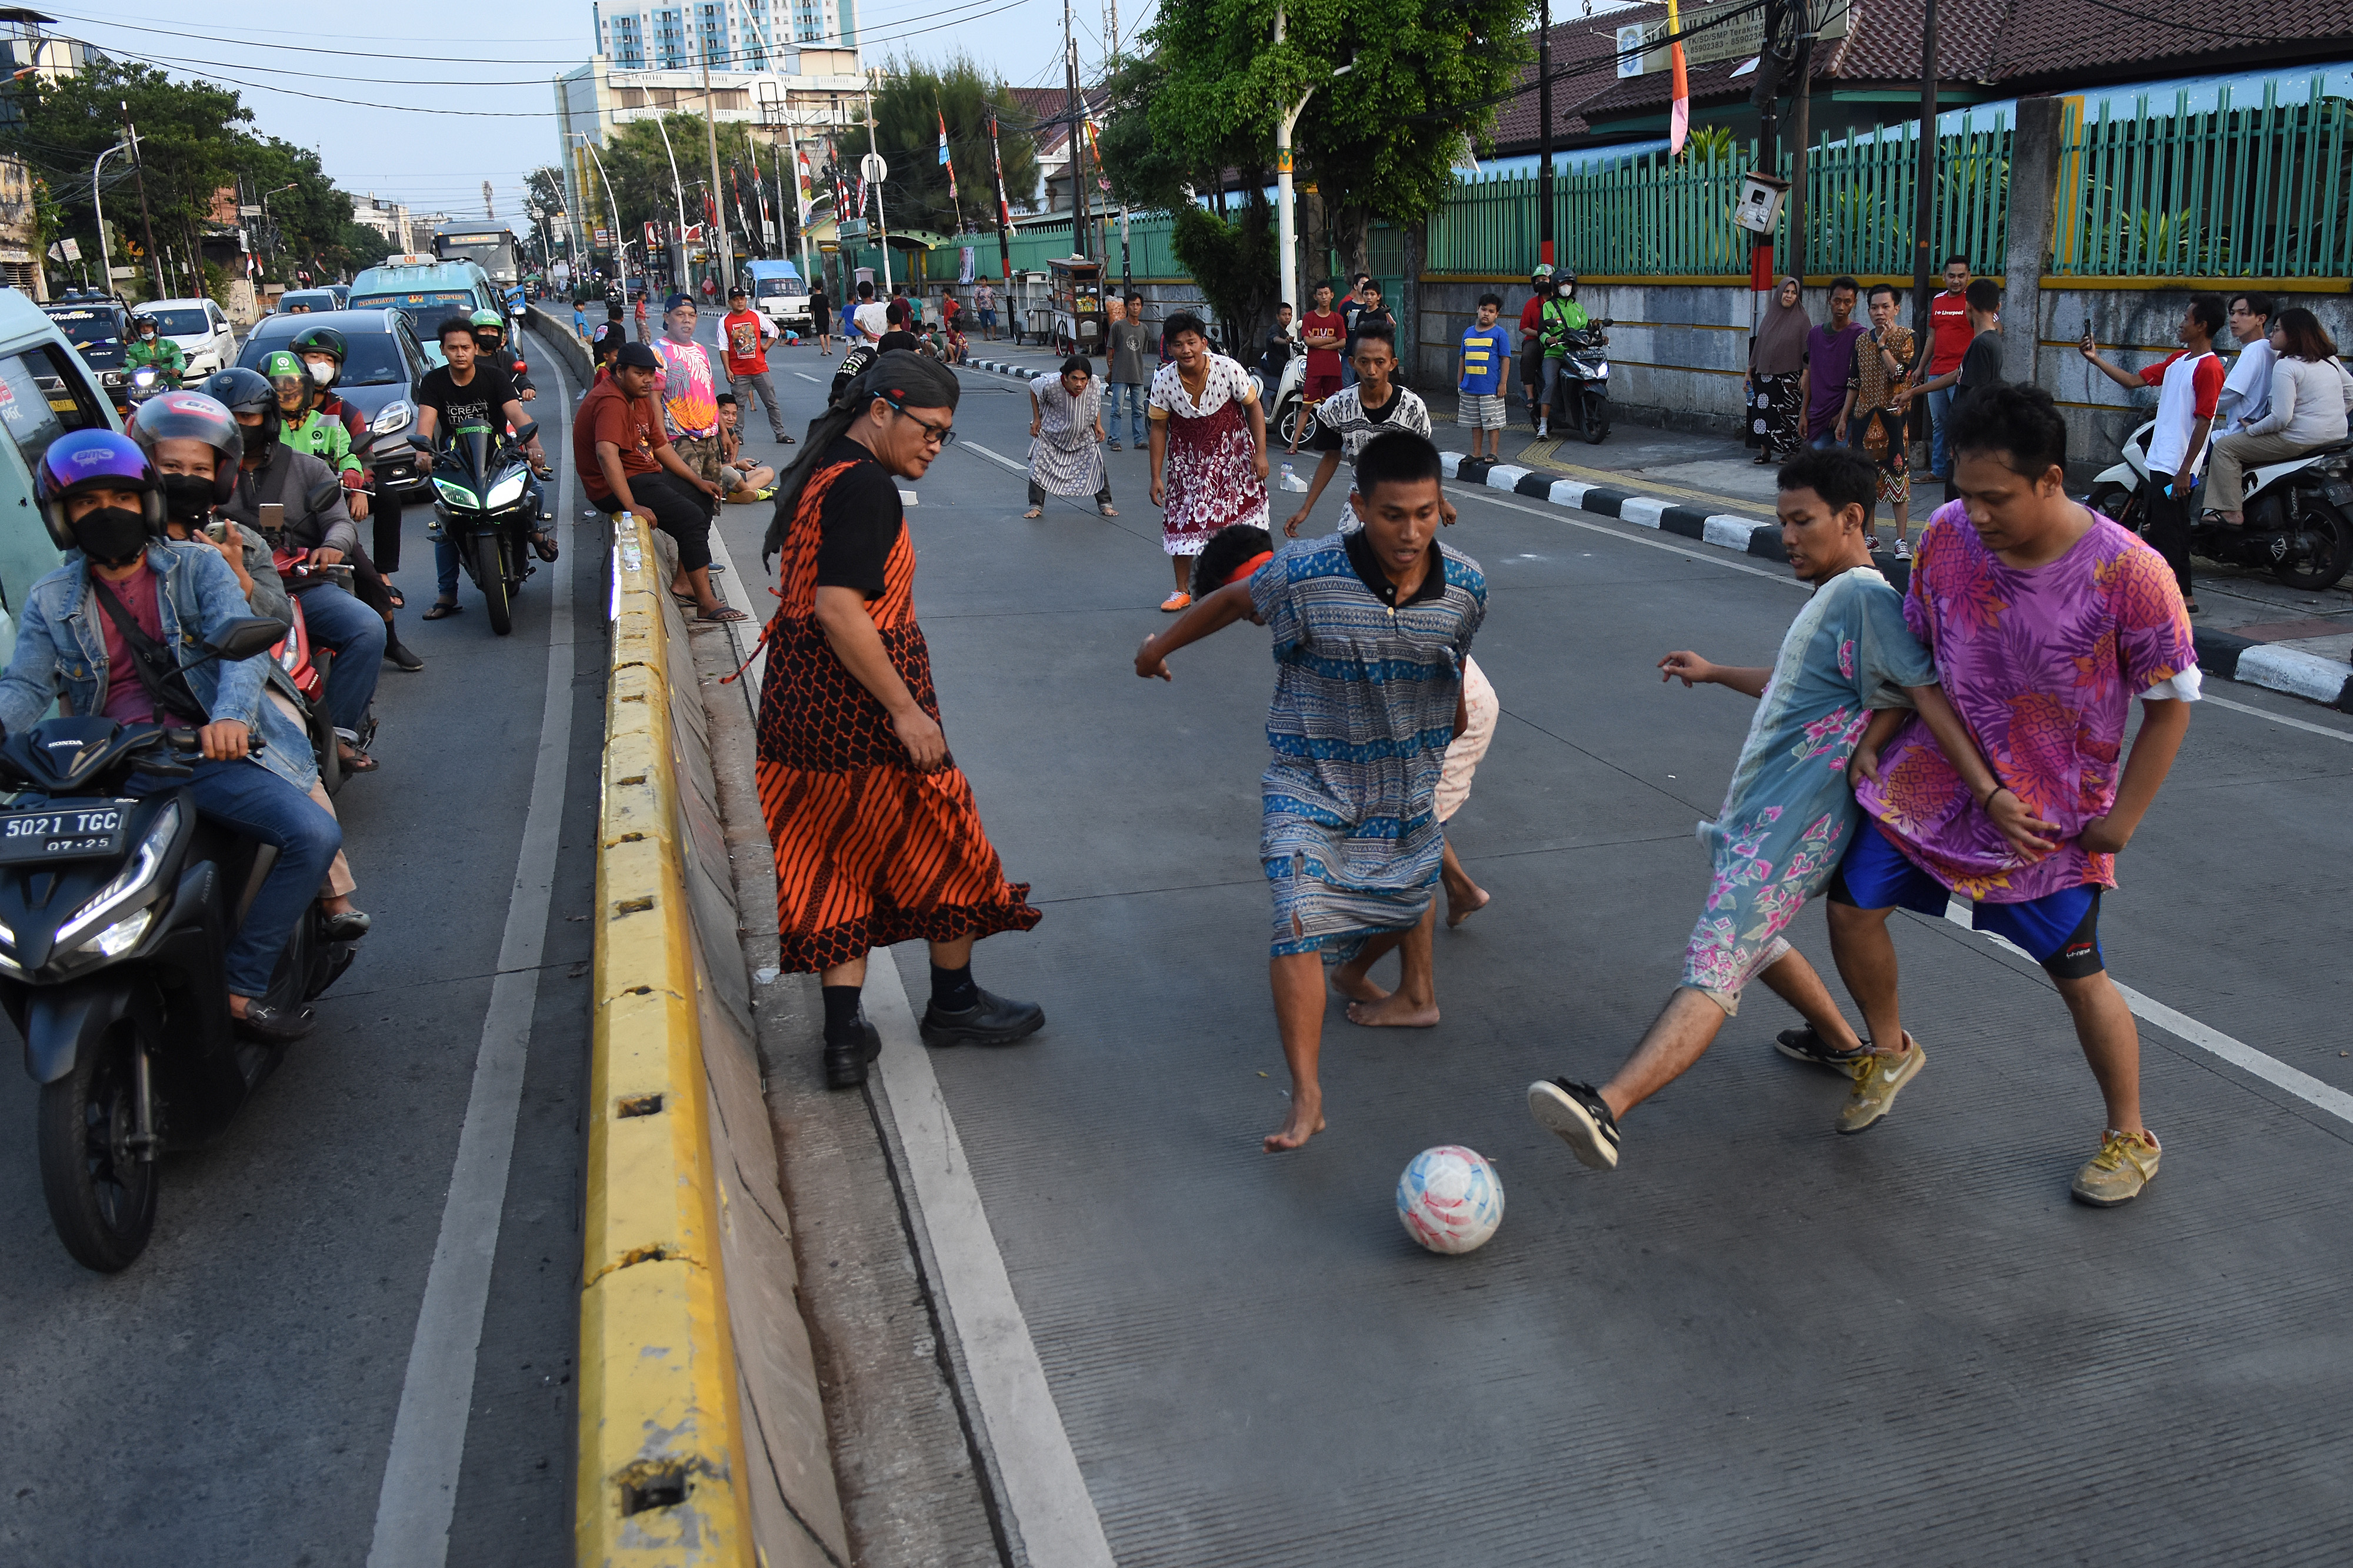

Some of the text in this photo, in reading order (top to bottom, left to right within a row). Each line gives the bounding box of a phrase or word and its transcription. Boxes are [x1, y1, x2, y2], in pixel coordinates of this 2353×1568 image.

[1688, 31, 1728, 45] TK/SD/SMP
[1691, 41, 1724, 54] 85902383
[404, 255, 417, 263] 01
[408, 294, 424, 303] 01
[76, 450, 110, 461] BMC
[48, 740, 84, 748] HONDA
[6, 812, 118, 836] 5021 TGC
